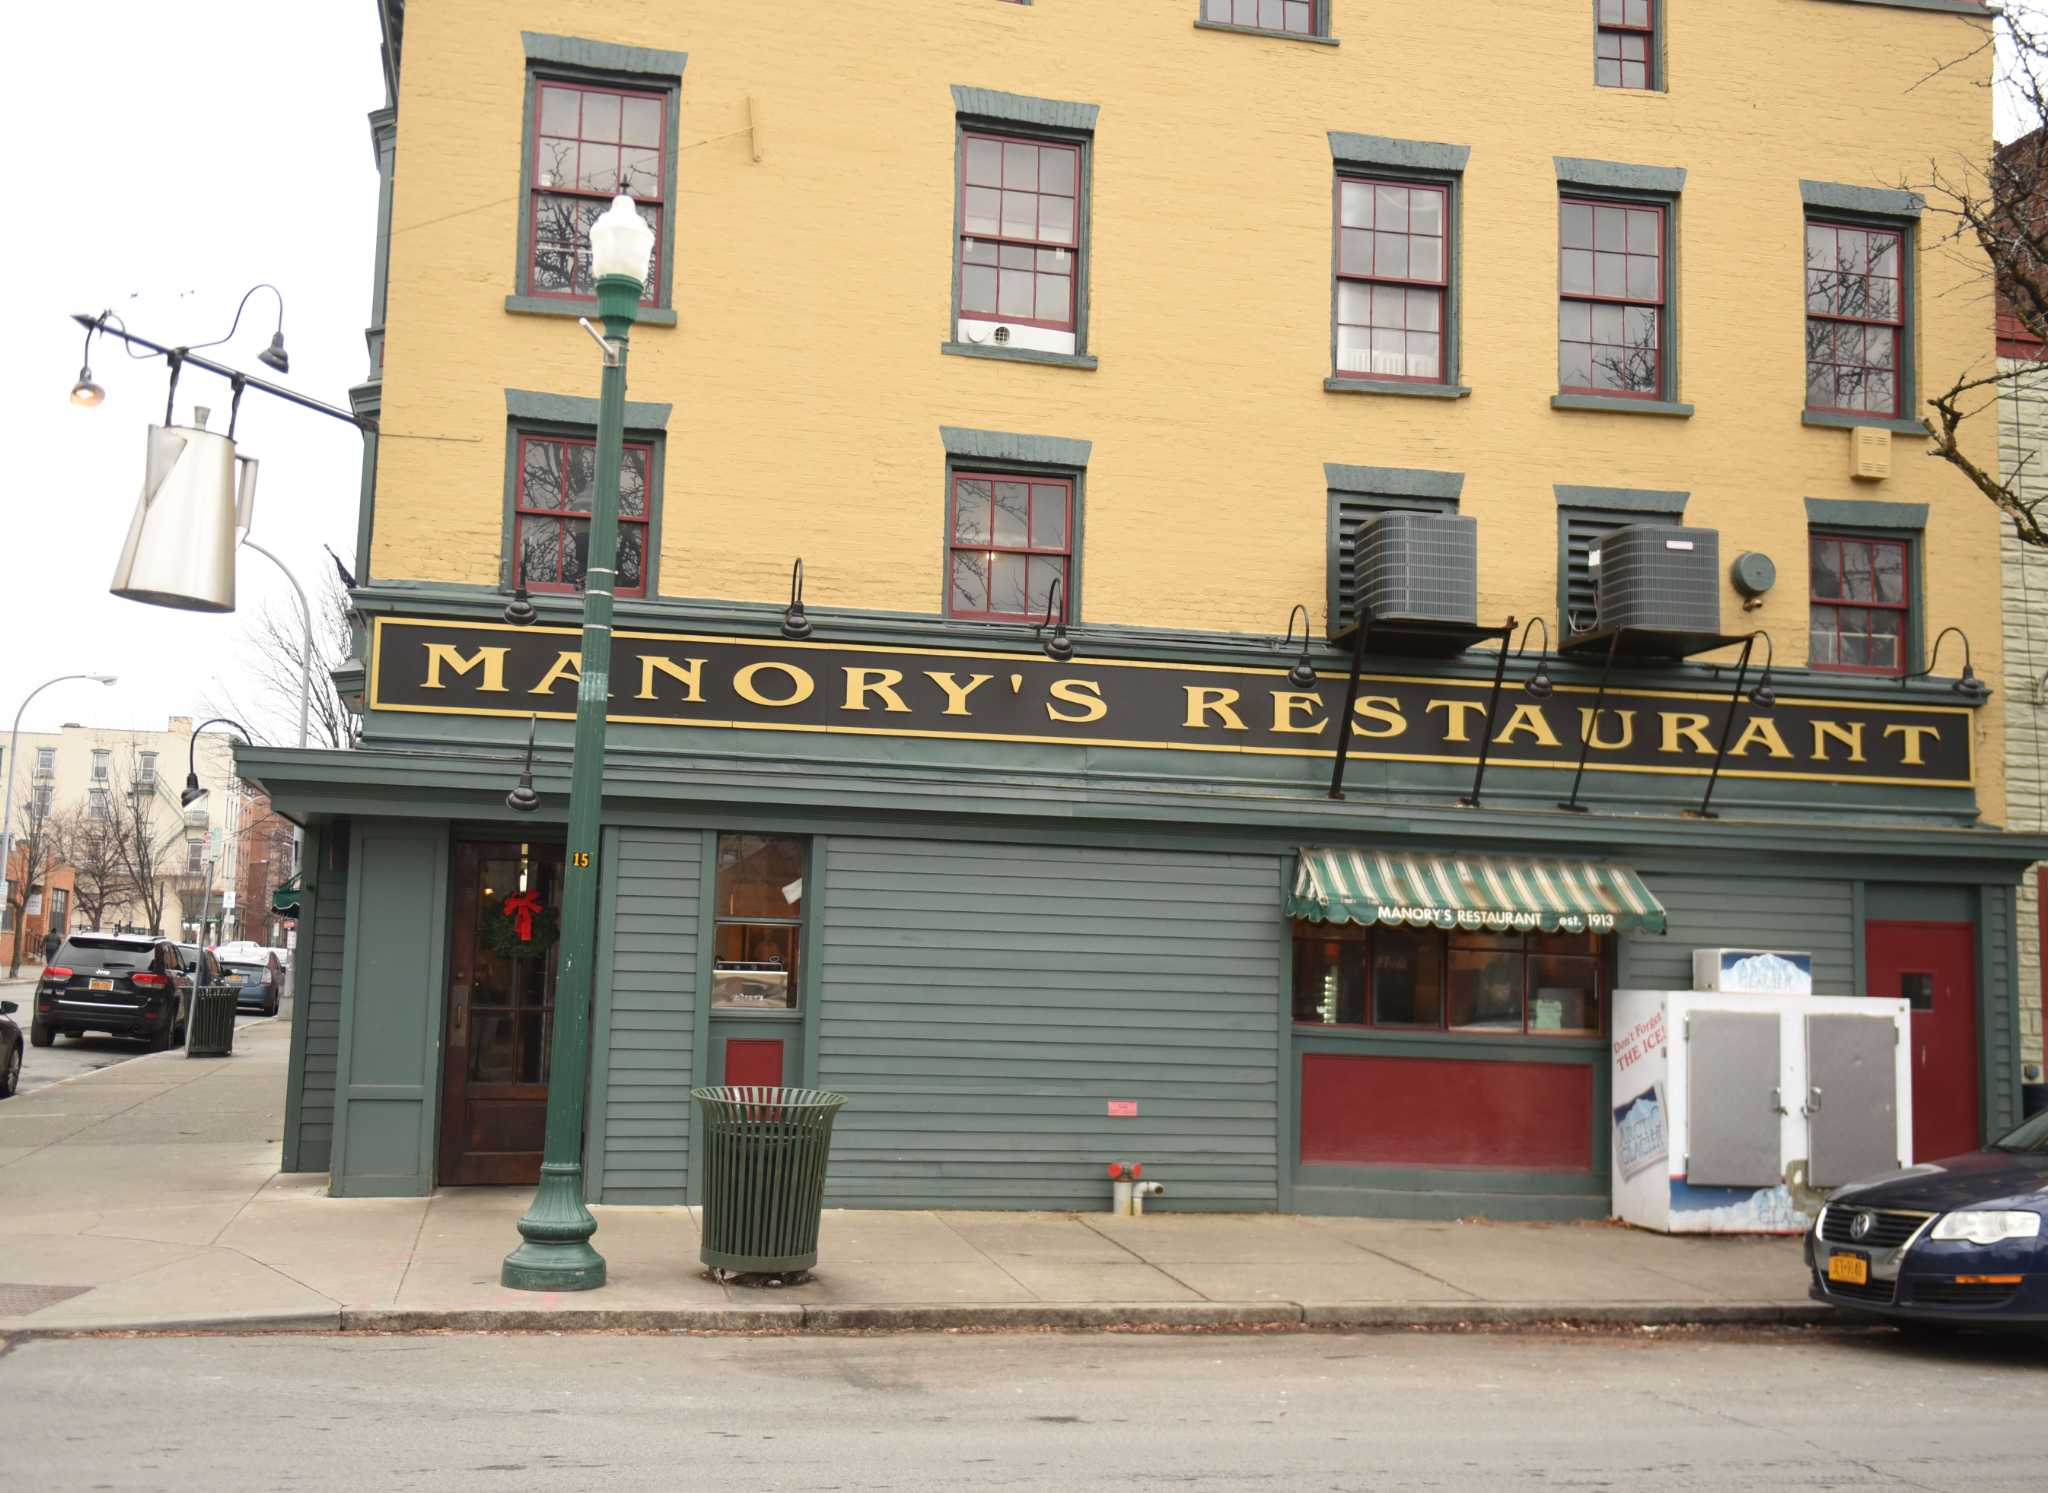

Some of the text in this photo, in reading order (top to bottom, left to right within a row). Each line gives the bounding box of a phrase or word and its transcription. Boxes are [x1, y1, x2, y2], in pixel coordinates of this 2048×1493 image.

[419, 640, 1942, 767] MANORY'S RESTAURANT
[573, 851, 590, 869] 15
[1377, 906, 1615, 928] MANORY'S RESTAURANT est. 1913
[1616, 1044, 1642, 1071] THE
